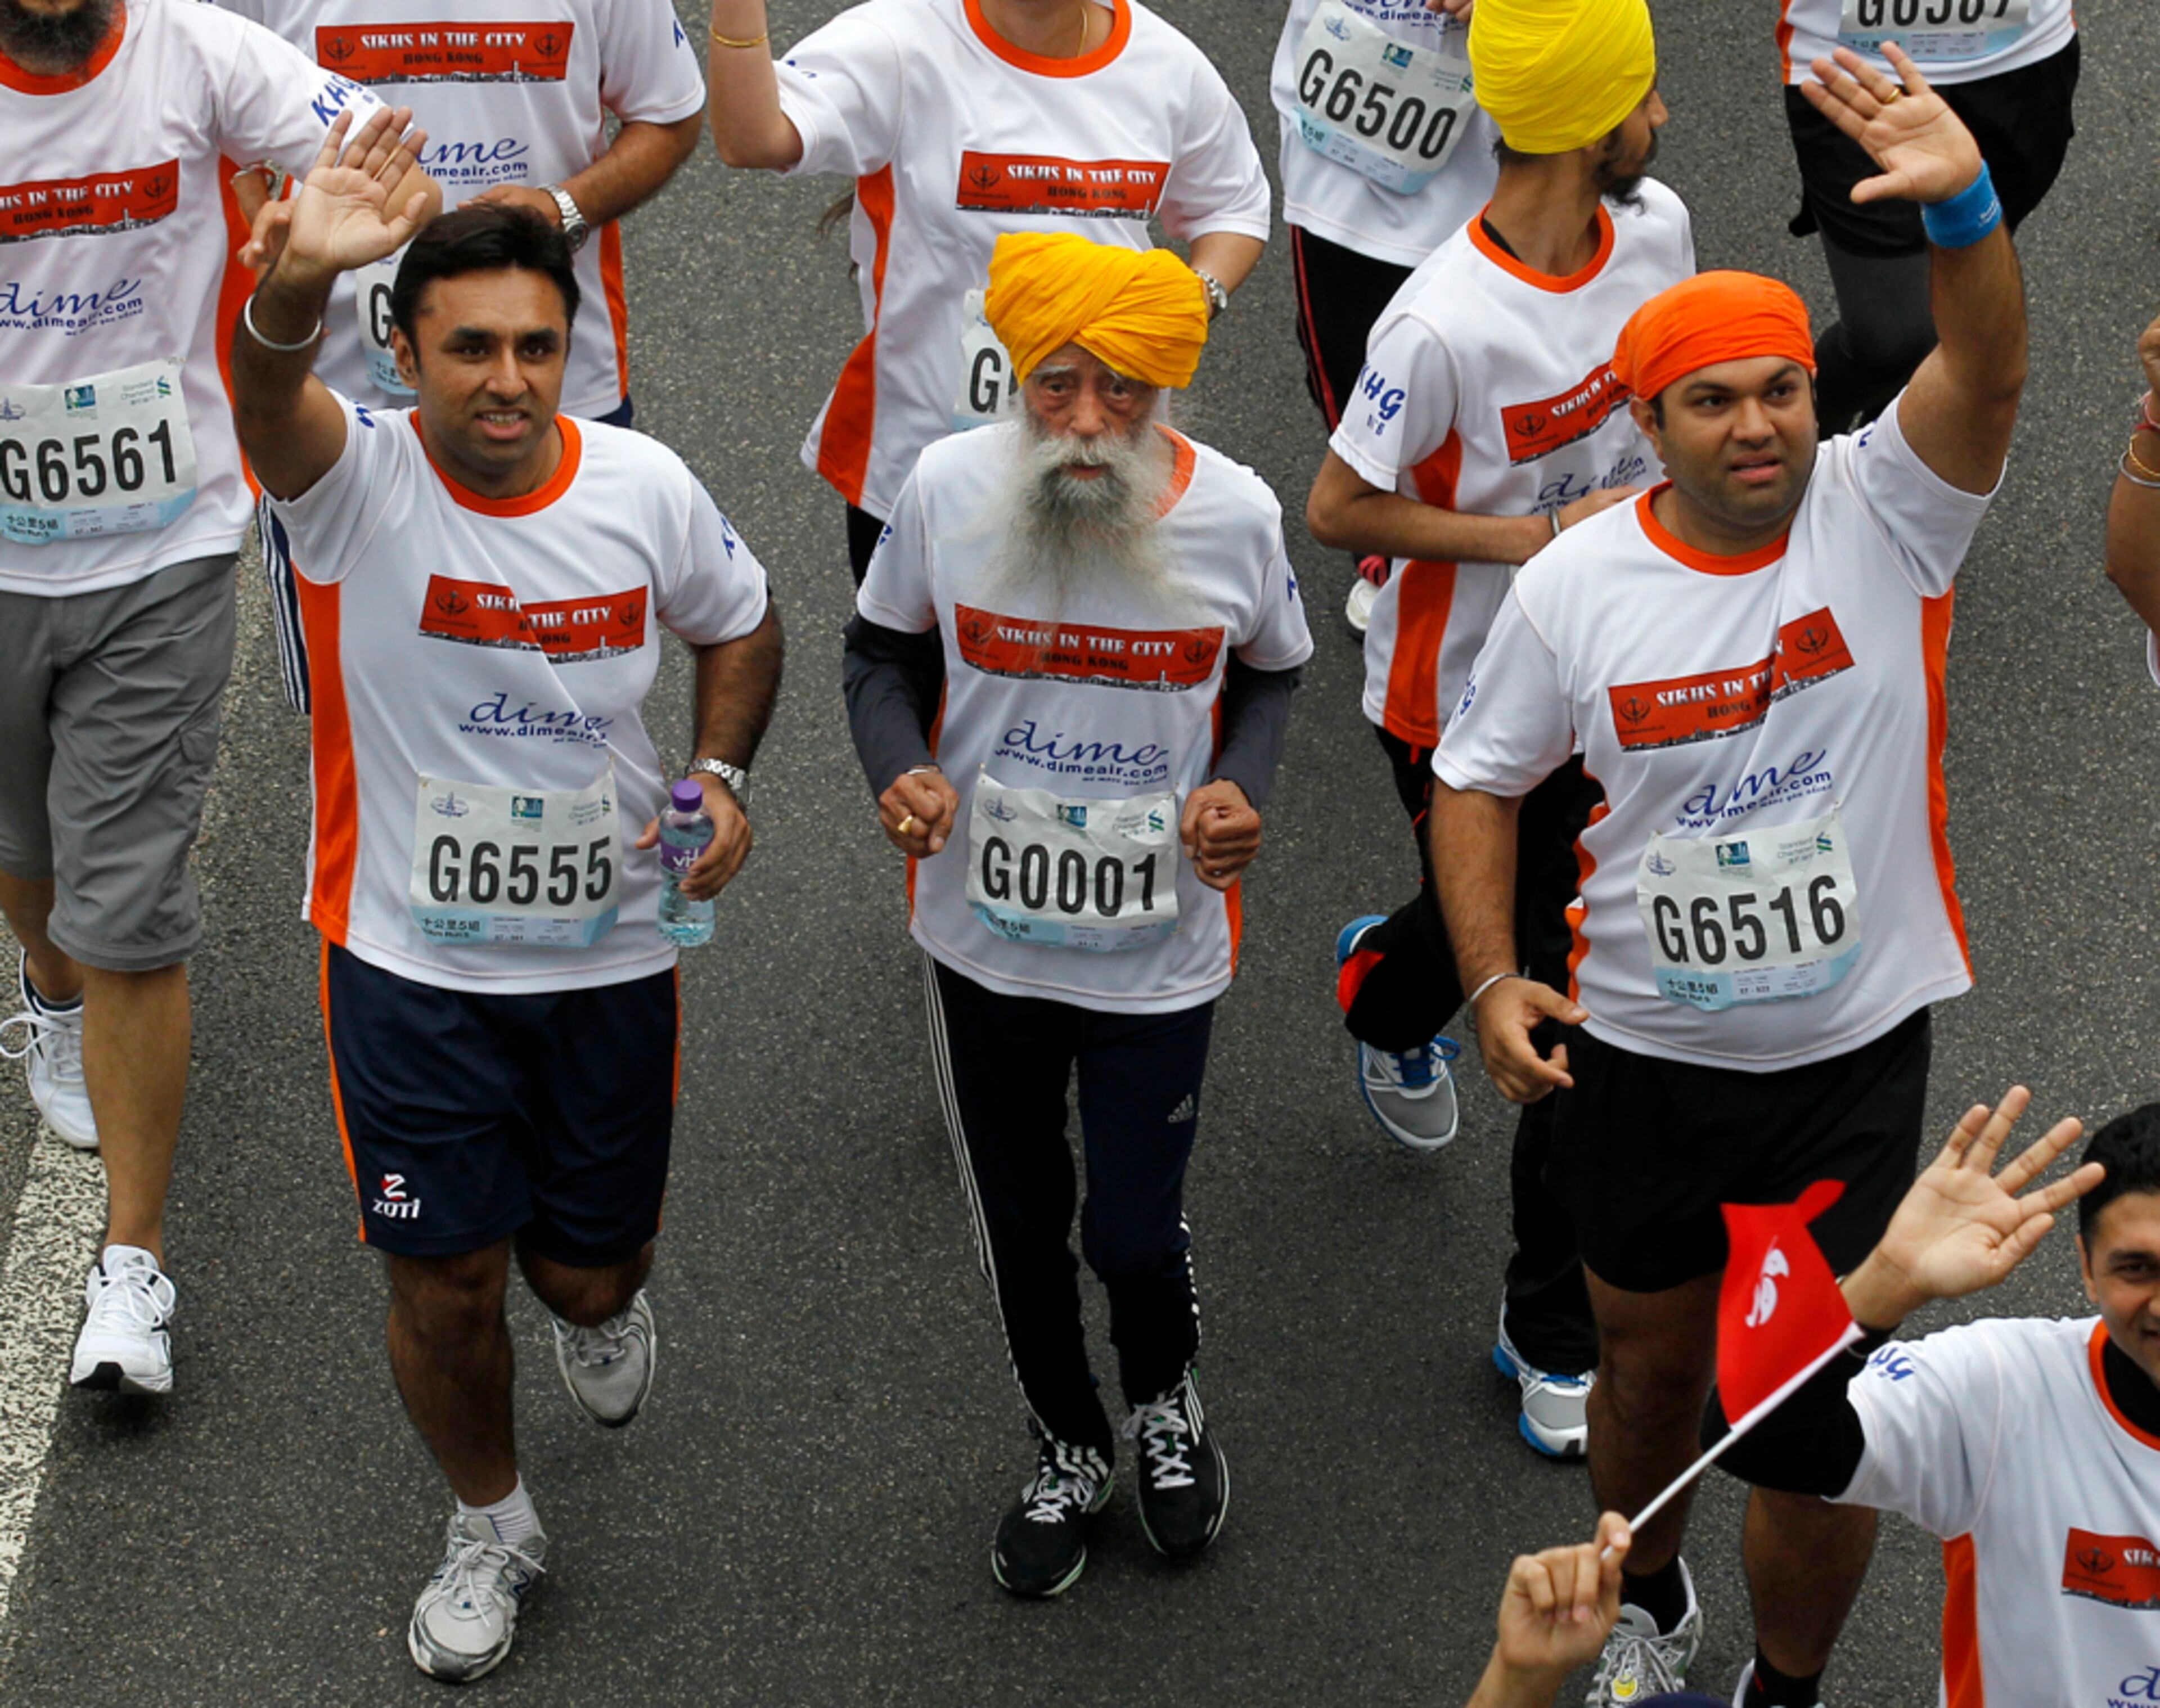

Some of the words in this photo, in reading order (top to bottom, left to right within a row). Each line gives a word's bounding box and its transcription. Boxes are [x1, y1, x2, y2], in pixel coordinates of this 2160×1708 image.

[361, 34, 413, 49] SIKHS
[420, 33, 438, 47] IN
[444, 32, 478, 48] THE
[485, 32, 525, 47] CITY
[403, 53, 442, 65] HONG
[446, 52, 483, 64] KONG
[1299, 48, 1457, 160] G6500
[1007, 164, 1060, 181] SIKHS
[1066, 168, 1083, 182] IN
[1088, 169, 1122, 184] THE
[1127, 170, 1156, 184] CITY
[28, 191, 47, 206] IN
[53, 187, 88, 201] THE
[95, 181, 133, 196] CITY
[1048, 186, 1087, 198] HONG
[1092, 188, 1126, 199] KONG
[0, 279, 141, 317] dime
[0, 419, 176, 502] G6561
[528, 611, 565, 628] THE
[572, 606, 611, 625] CITY
[997, 626, 1052, 647] SIKHS
[1059, 634, 1079, 648] IN
[1087, 636, 1125, 653] THE
[1131, 641, 1175, 656] CITY
[1041, 652, 1082, 666] HONG
[1087, 655, 1128, 670] KONG
[1657, 683, 1717, 706] SIKHS
[1722, 679, 1744, 697] IN
[1707, 700, 1750, 718] HONG
[1004, 720, 1168, 764] dime
[994, 748, 1167, 778] www.dimeair.com
[429, 835, 611, 906] G6555
[982, 836, 1156, 917] G0001
[1653, 875, 1845, 965] G6516
